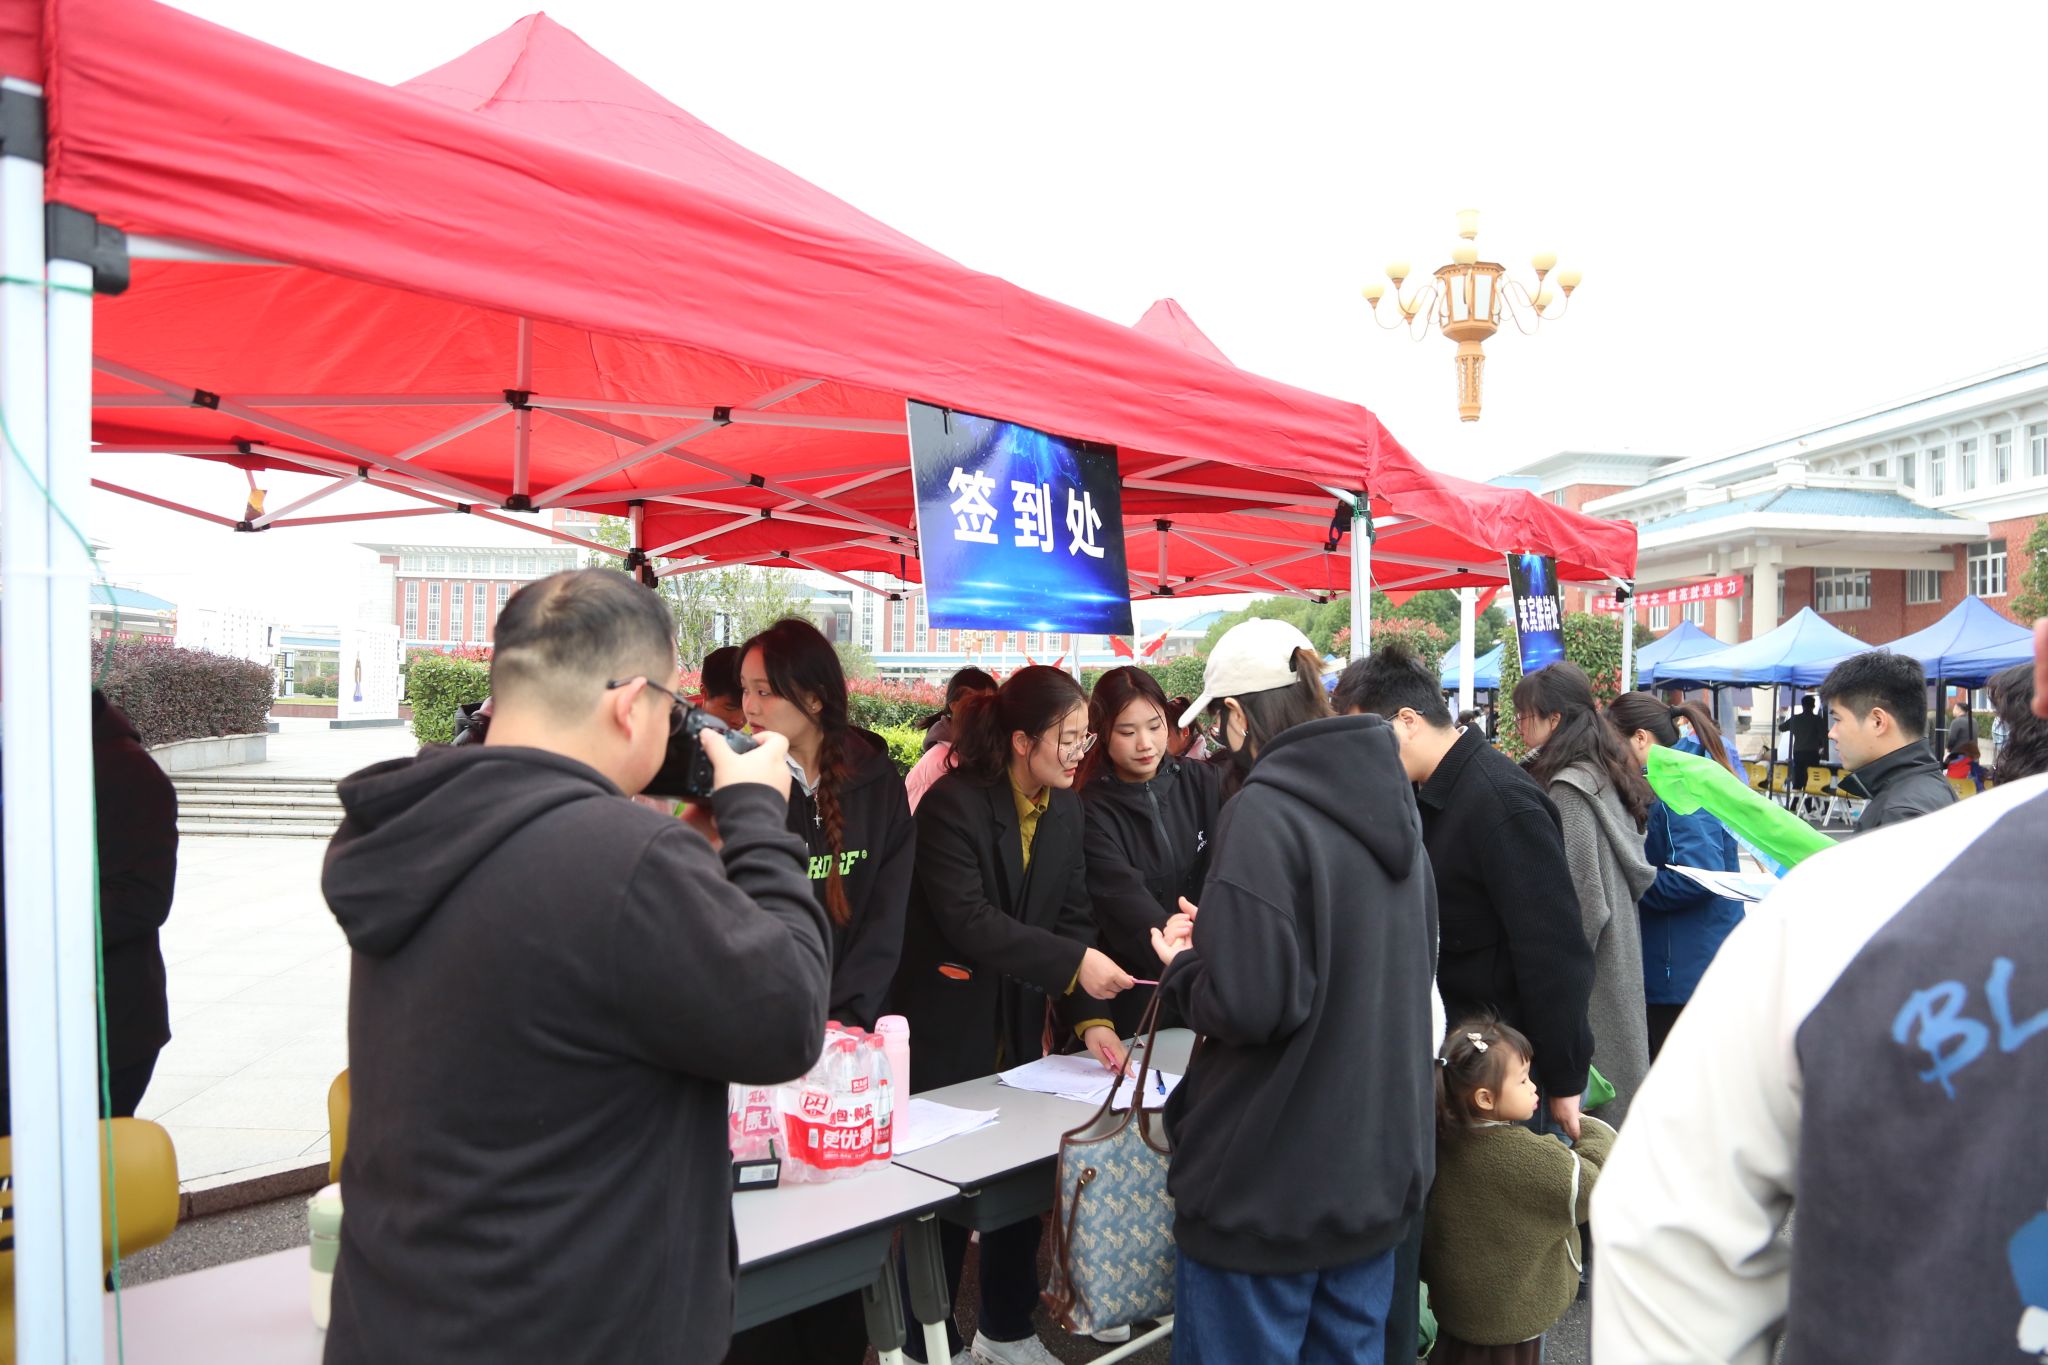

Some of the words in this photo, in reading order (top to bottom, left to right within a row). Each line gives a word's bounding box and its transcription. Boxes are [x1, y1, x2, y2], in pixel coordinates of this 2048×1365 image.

[948, 467, 1104, 559] 签到处
[1669, 580, 1736, 602] 提高就业能力
[1519, 595, 1560, 633] 来宾接待处
[823, 1125, 873, 1150] 更优惠
